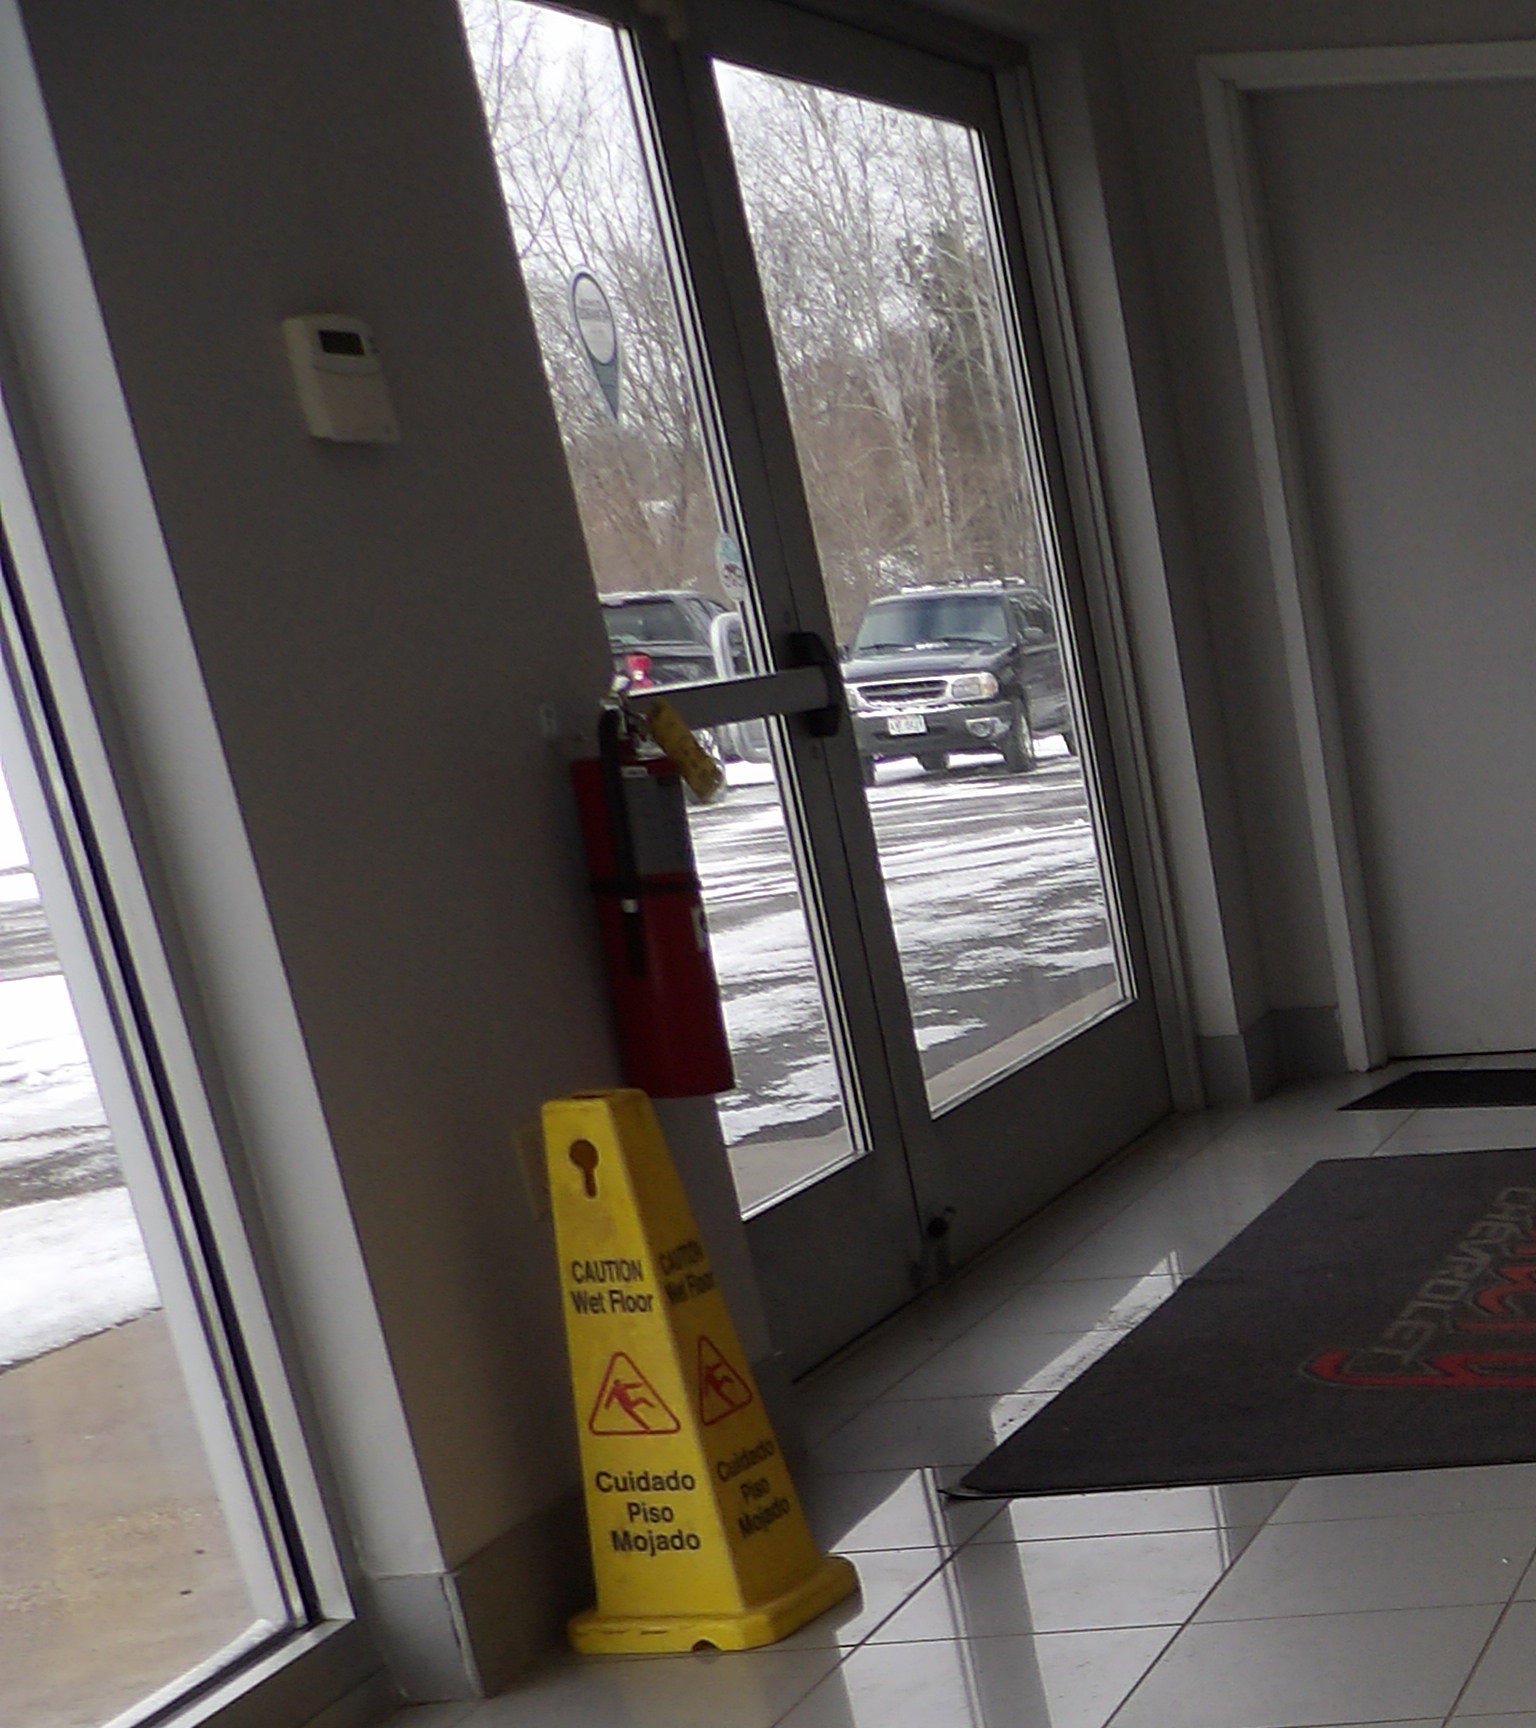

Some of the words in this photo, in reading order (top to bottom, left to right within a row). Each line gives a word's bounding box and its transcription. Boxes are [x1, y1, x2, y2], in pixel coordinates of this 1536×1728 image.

[572, 1258, 643, 1283] CAUTION
[571, 1290, 605, 1315] Wet
[609, 1289, 654, 1314] Floor
[595, 1470, 696, 1493] Cuidado
[627, 1502, 674, 1524] Piso
[611, 1529, 702, 1558] Mojado
